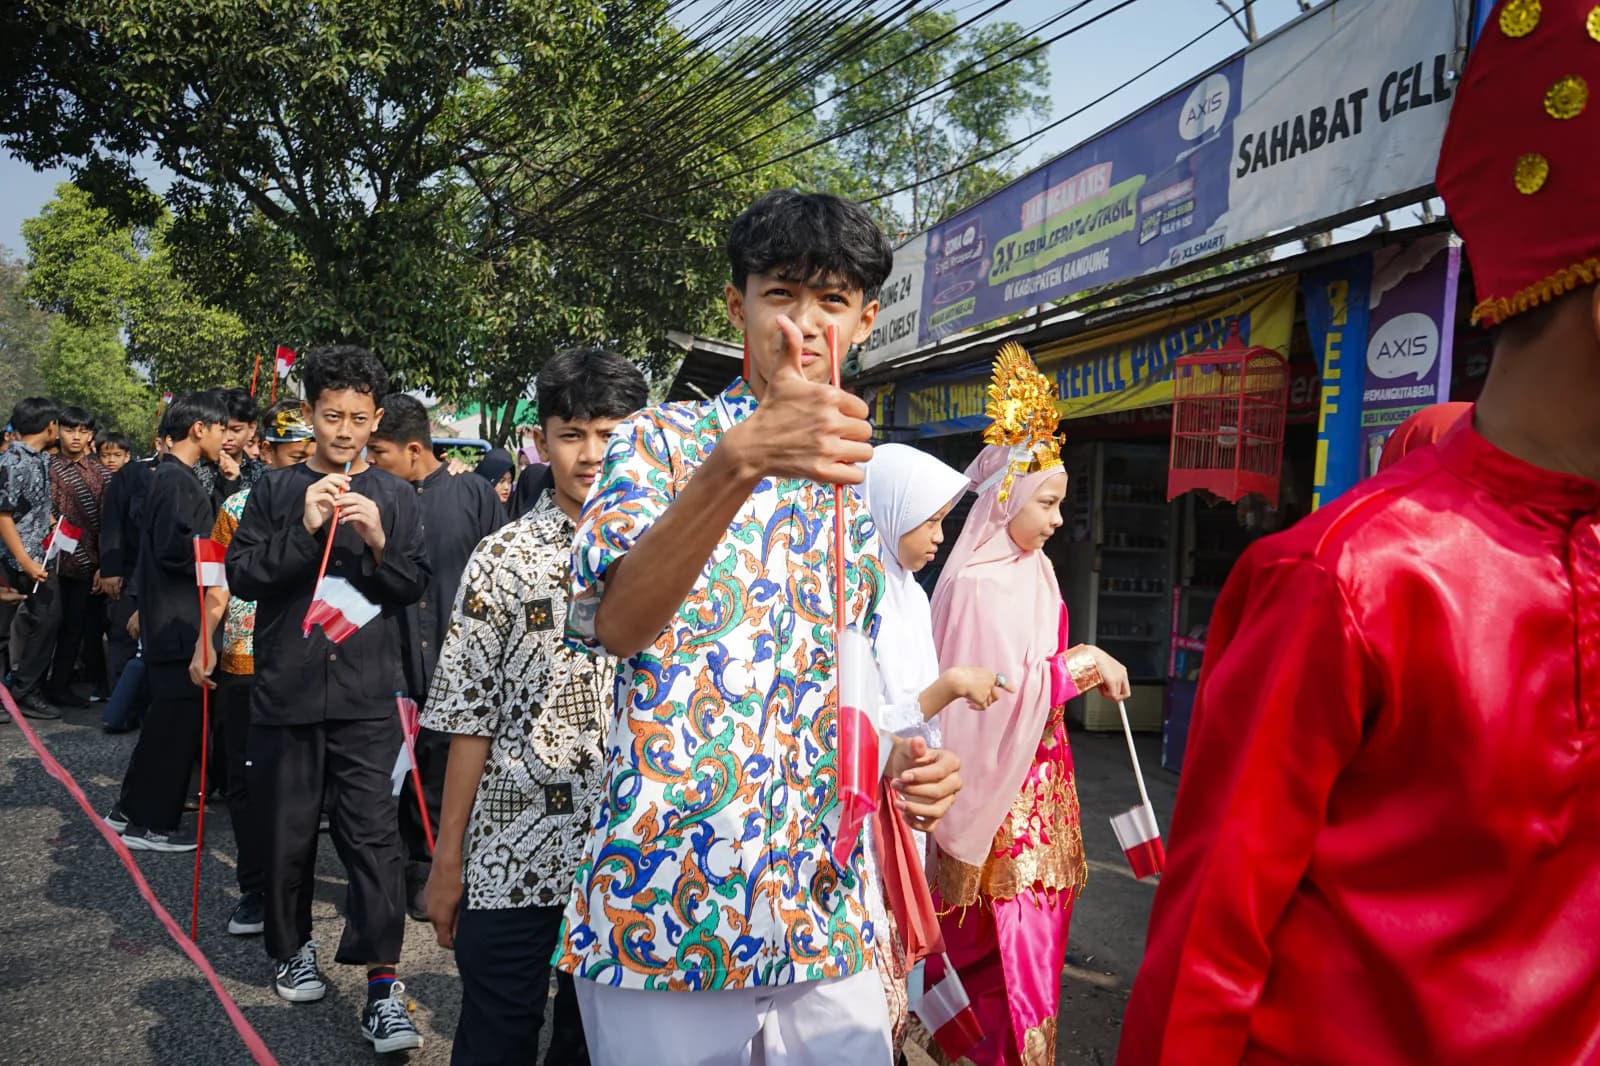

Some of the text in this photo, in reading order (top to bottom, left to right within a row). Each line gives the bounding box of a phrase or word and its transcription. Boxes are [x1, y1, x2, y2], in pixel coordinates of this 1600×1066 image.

[1185, 91, 1223, 126] AXIS
[1236, 53, 1452, 179] SAHABAT CELL
[1077, 166, 1107, 204] AXIS
[900, 273, 913, 302] 24
[1013, 267, 1063, 299] KABUPATEN
[1063, 247, 1110, 283] BANDUNG
[889, 310, 918, 345] CHELSY
[1376, 335, 1427, 360] AXIS
[1055, 347, 1127, 400] REFILL
